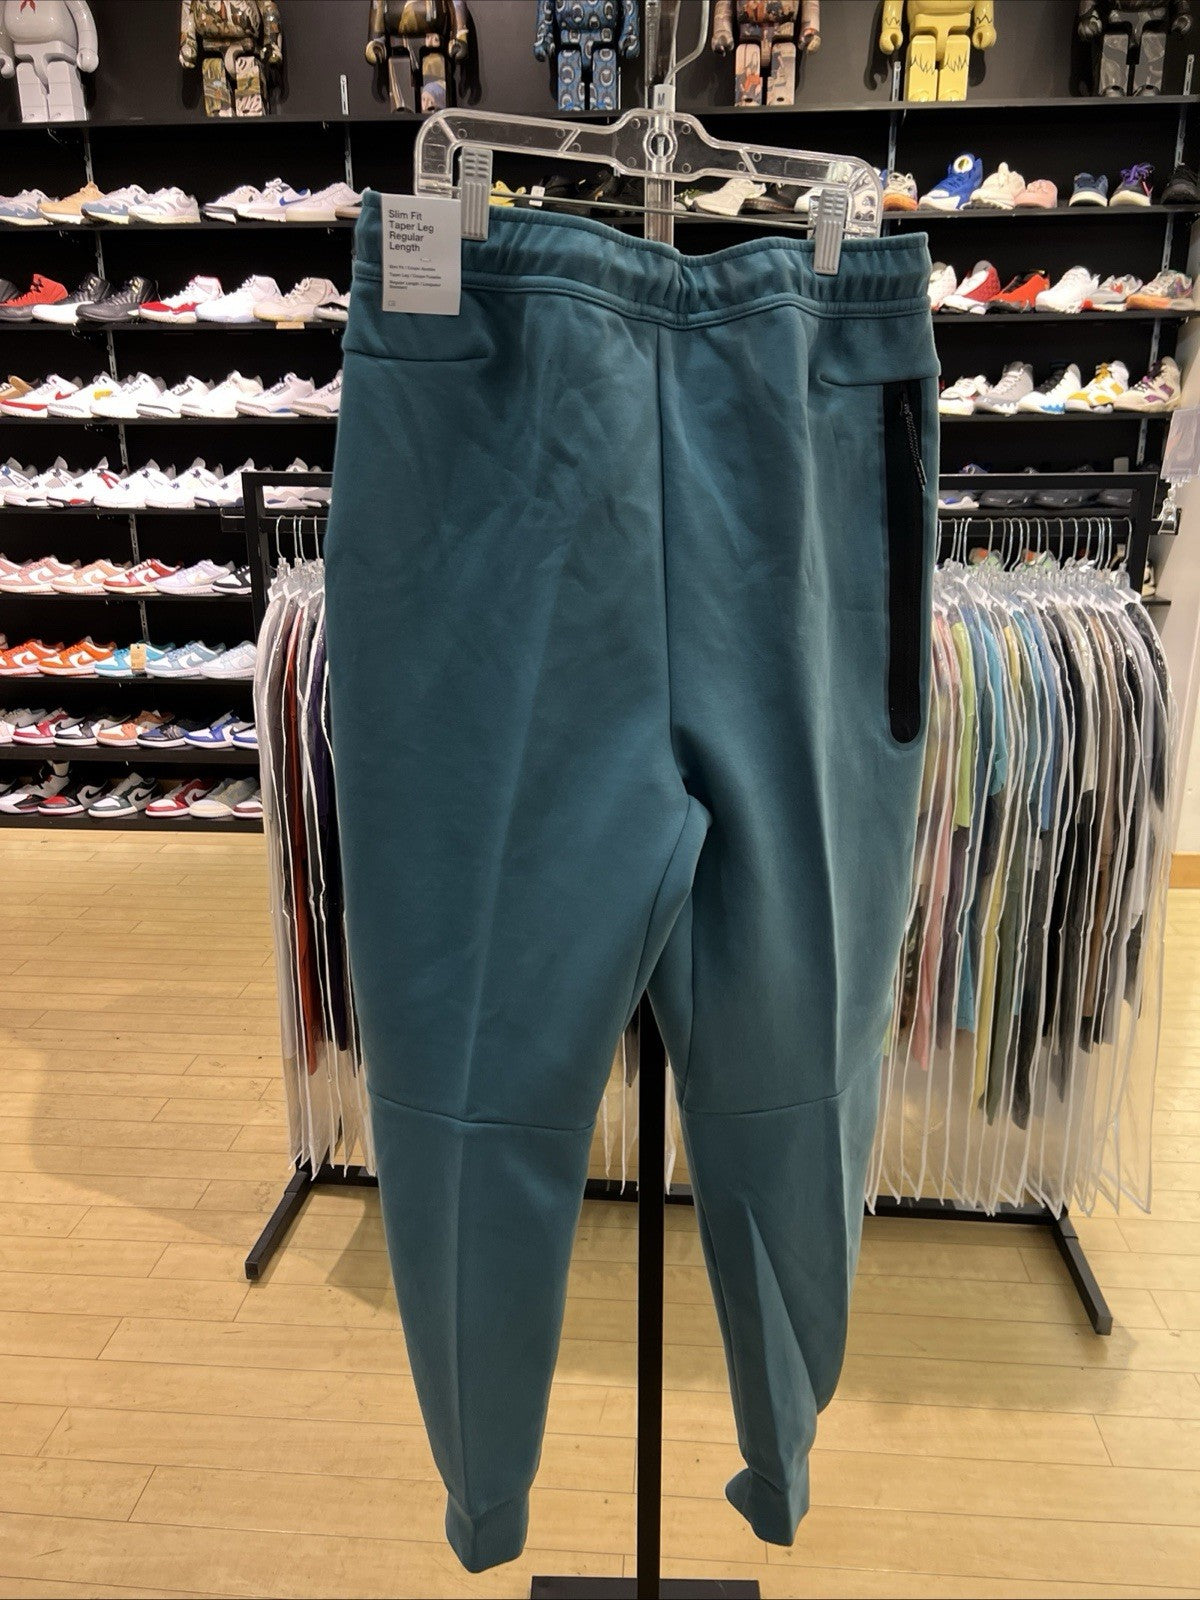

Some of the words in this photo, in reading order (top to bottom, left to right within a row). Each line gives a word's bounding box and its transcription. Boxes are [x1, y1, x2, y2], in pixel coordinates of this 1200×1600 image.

[657, 93, 665, 106] M
[389, 209, 408, 219] Slim
[410, 211, 423, 221] Fit
[389, 220, 415, 231] Taper
[417, 222, 435, 234] Leg
[389, 231, 424, 242] Regular
[389, 242, 421, 253] Length
